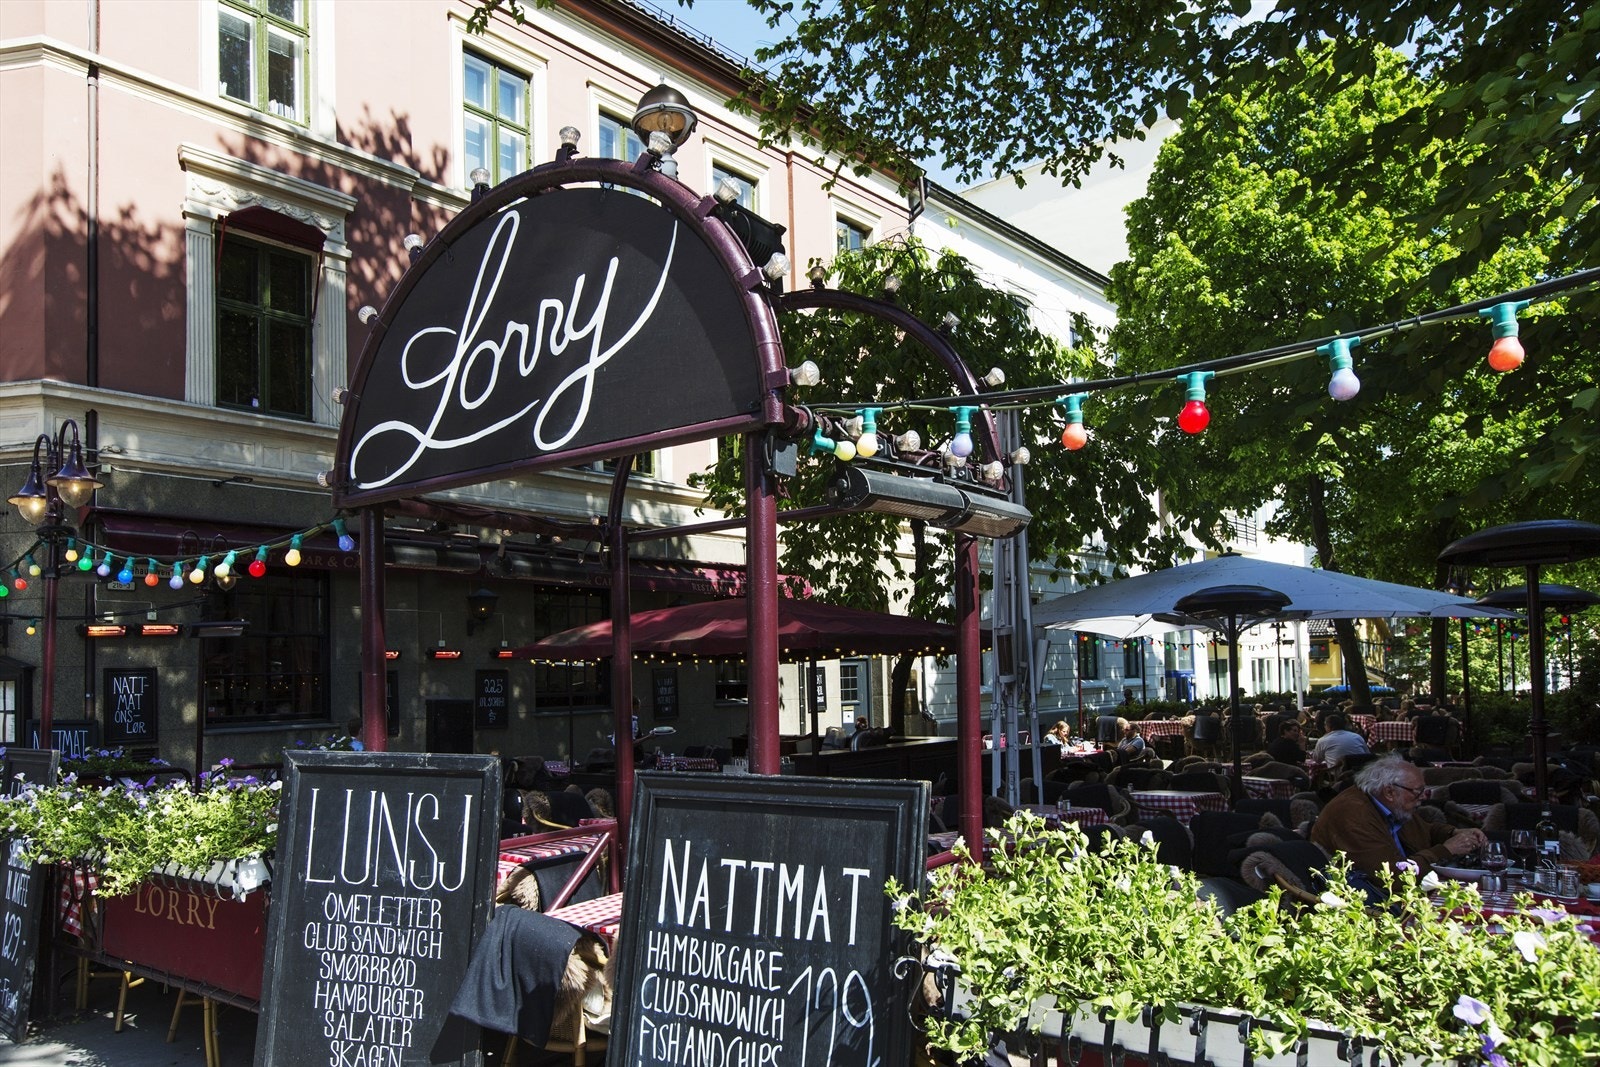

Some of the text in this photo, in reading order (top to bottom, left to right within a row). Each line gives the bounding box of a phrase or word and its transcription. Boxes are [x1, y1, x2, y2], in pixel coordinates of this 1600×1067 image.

[350, 210, 678, 489] Lorry
[117, 693, 143, 710] MAT
[305, 788, 473, 891] LUNSJ
[134, 883, 220, 930] LORRY
[324, 892, 442, 929] OMELETTER
[657, 838, 870, 946] NATTMAT
[320, 951, 417, 988] SMØRBRØD
[646, 930, 783, 991] HAMBURGARE
[314, 980, 424, 1019] HAMBURGER
[324, 1010, 413, 1047] SALATER
[330, 1040, 403, 1067] SKAGEN
